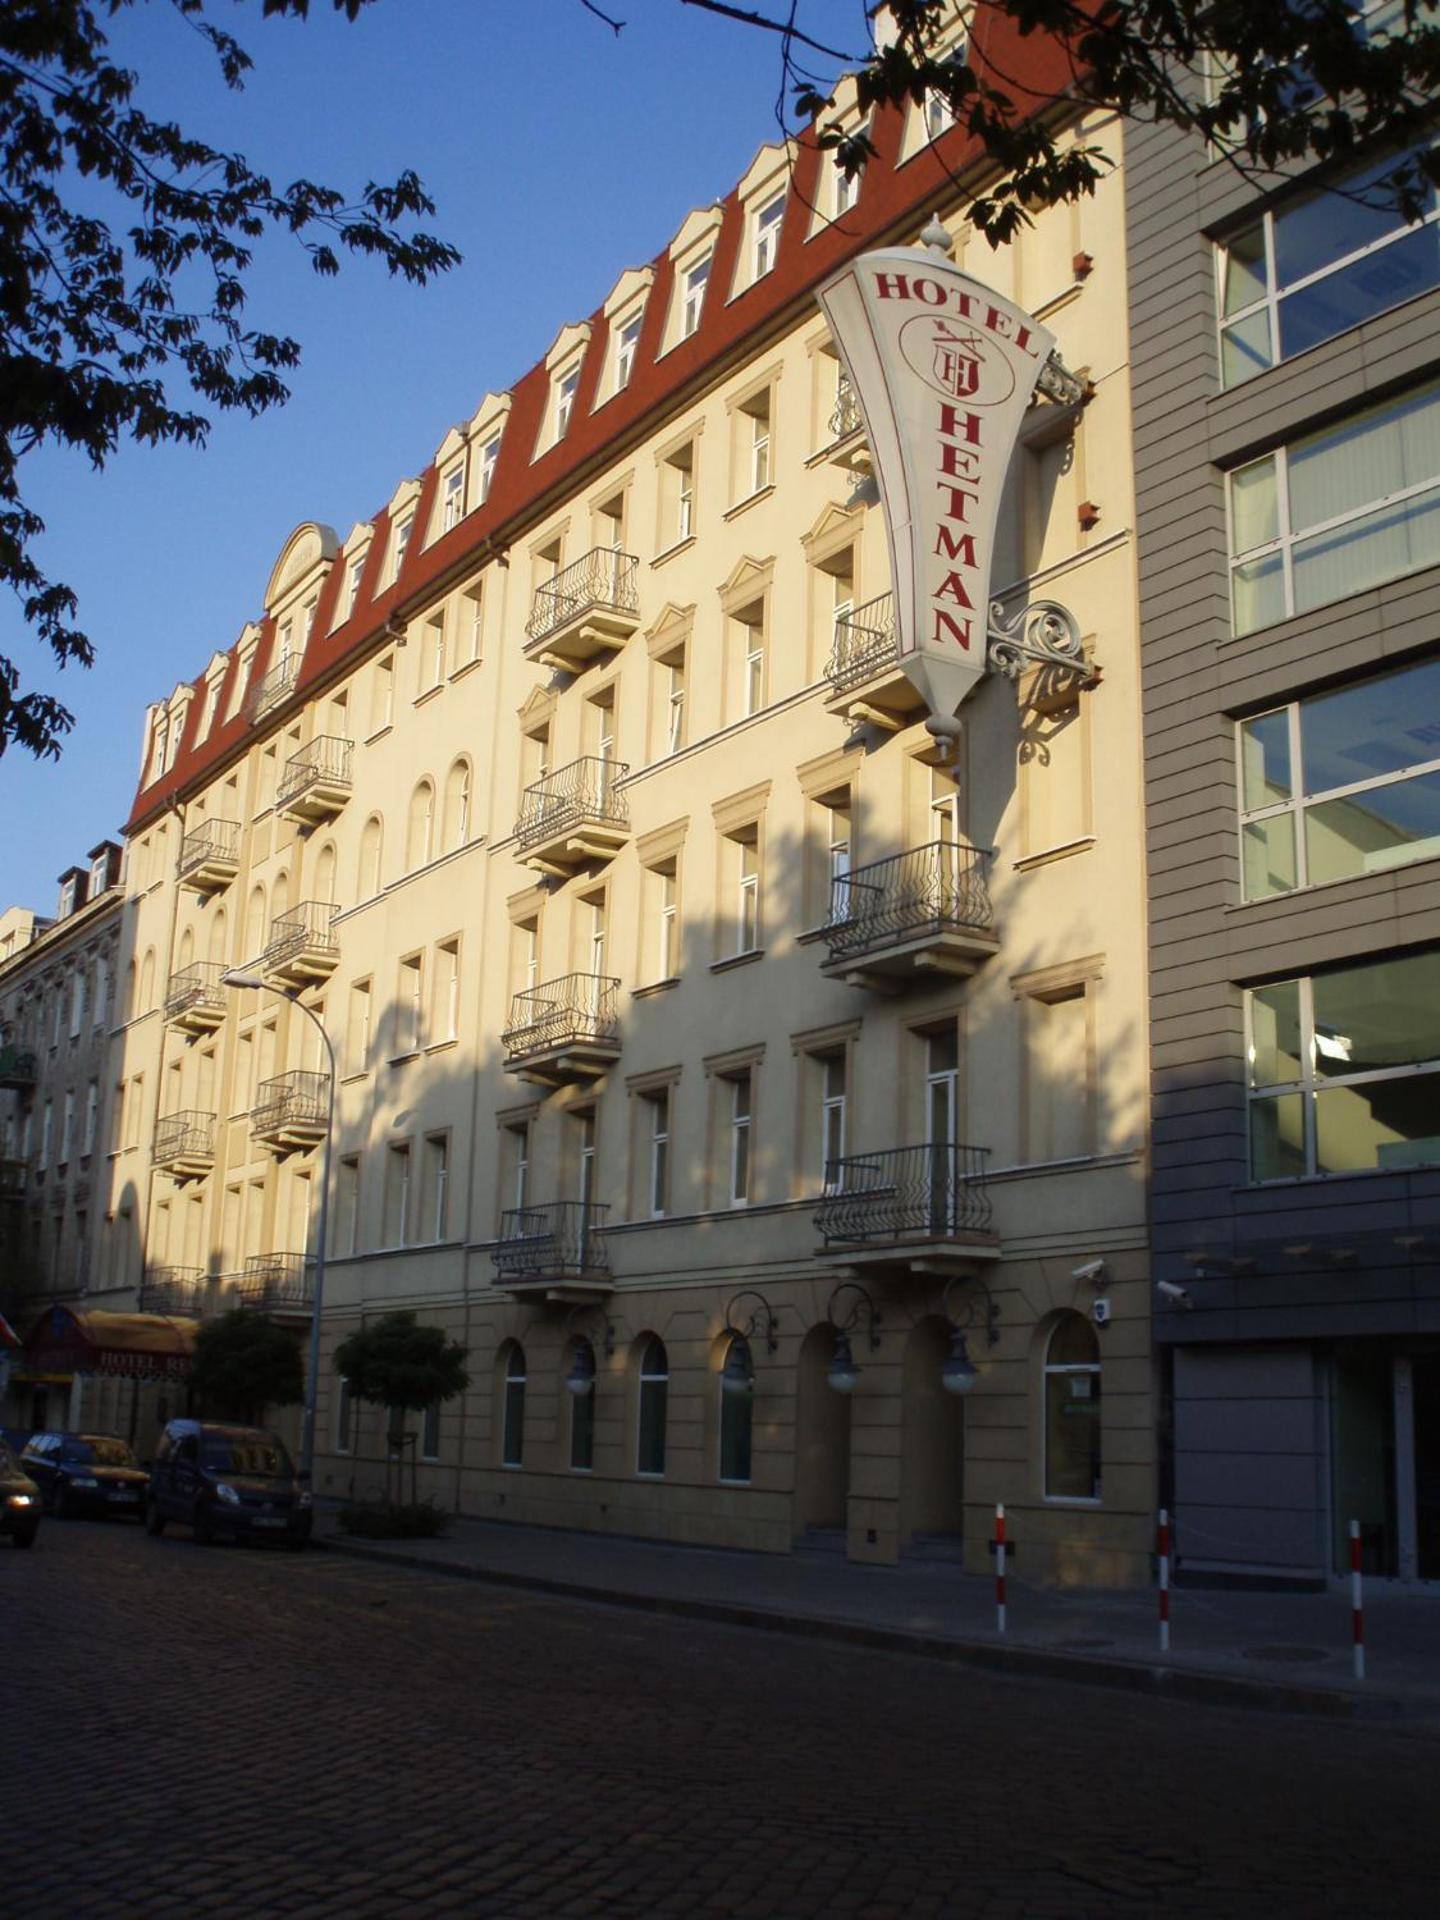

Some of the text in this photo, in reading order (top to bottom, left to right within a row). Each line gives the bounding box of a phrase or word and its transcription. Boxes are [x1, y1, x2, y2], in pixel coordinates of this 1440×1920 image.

[873, 271, 1040, 360] HOTEL
[932, 400, 984, 651] HETMAN
[101, 1352, 154, 1368] HOTEL
